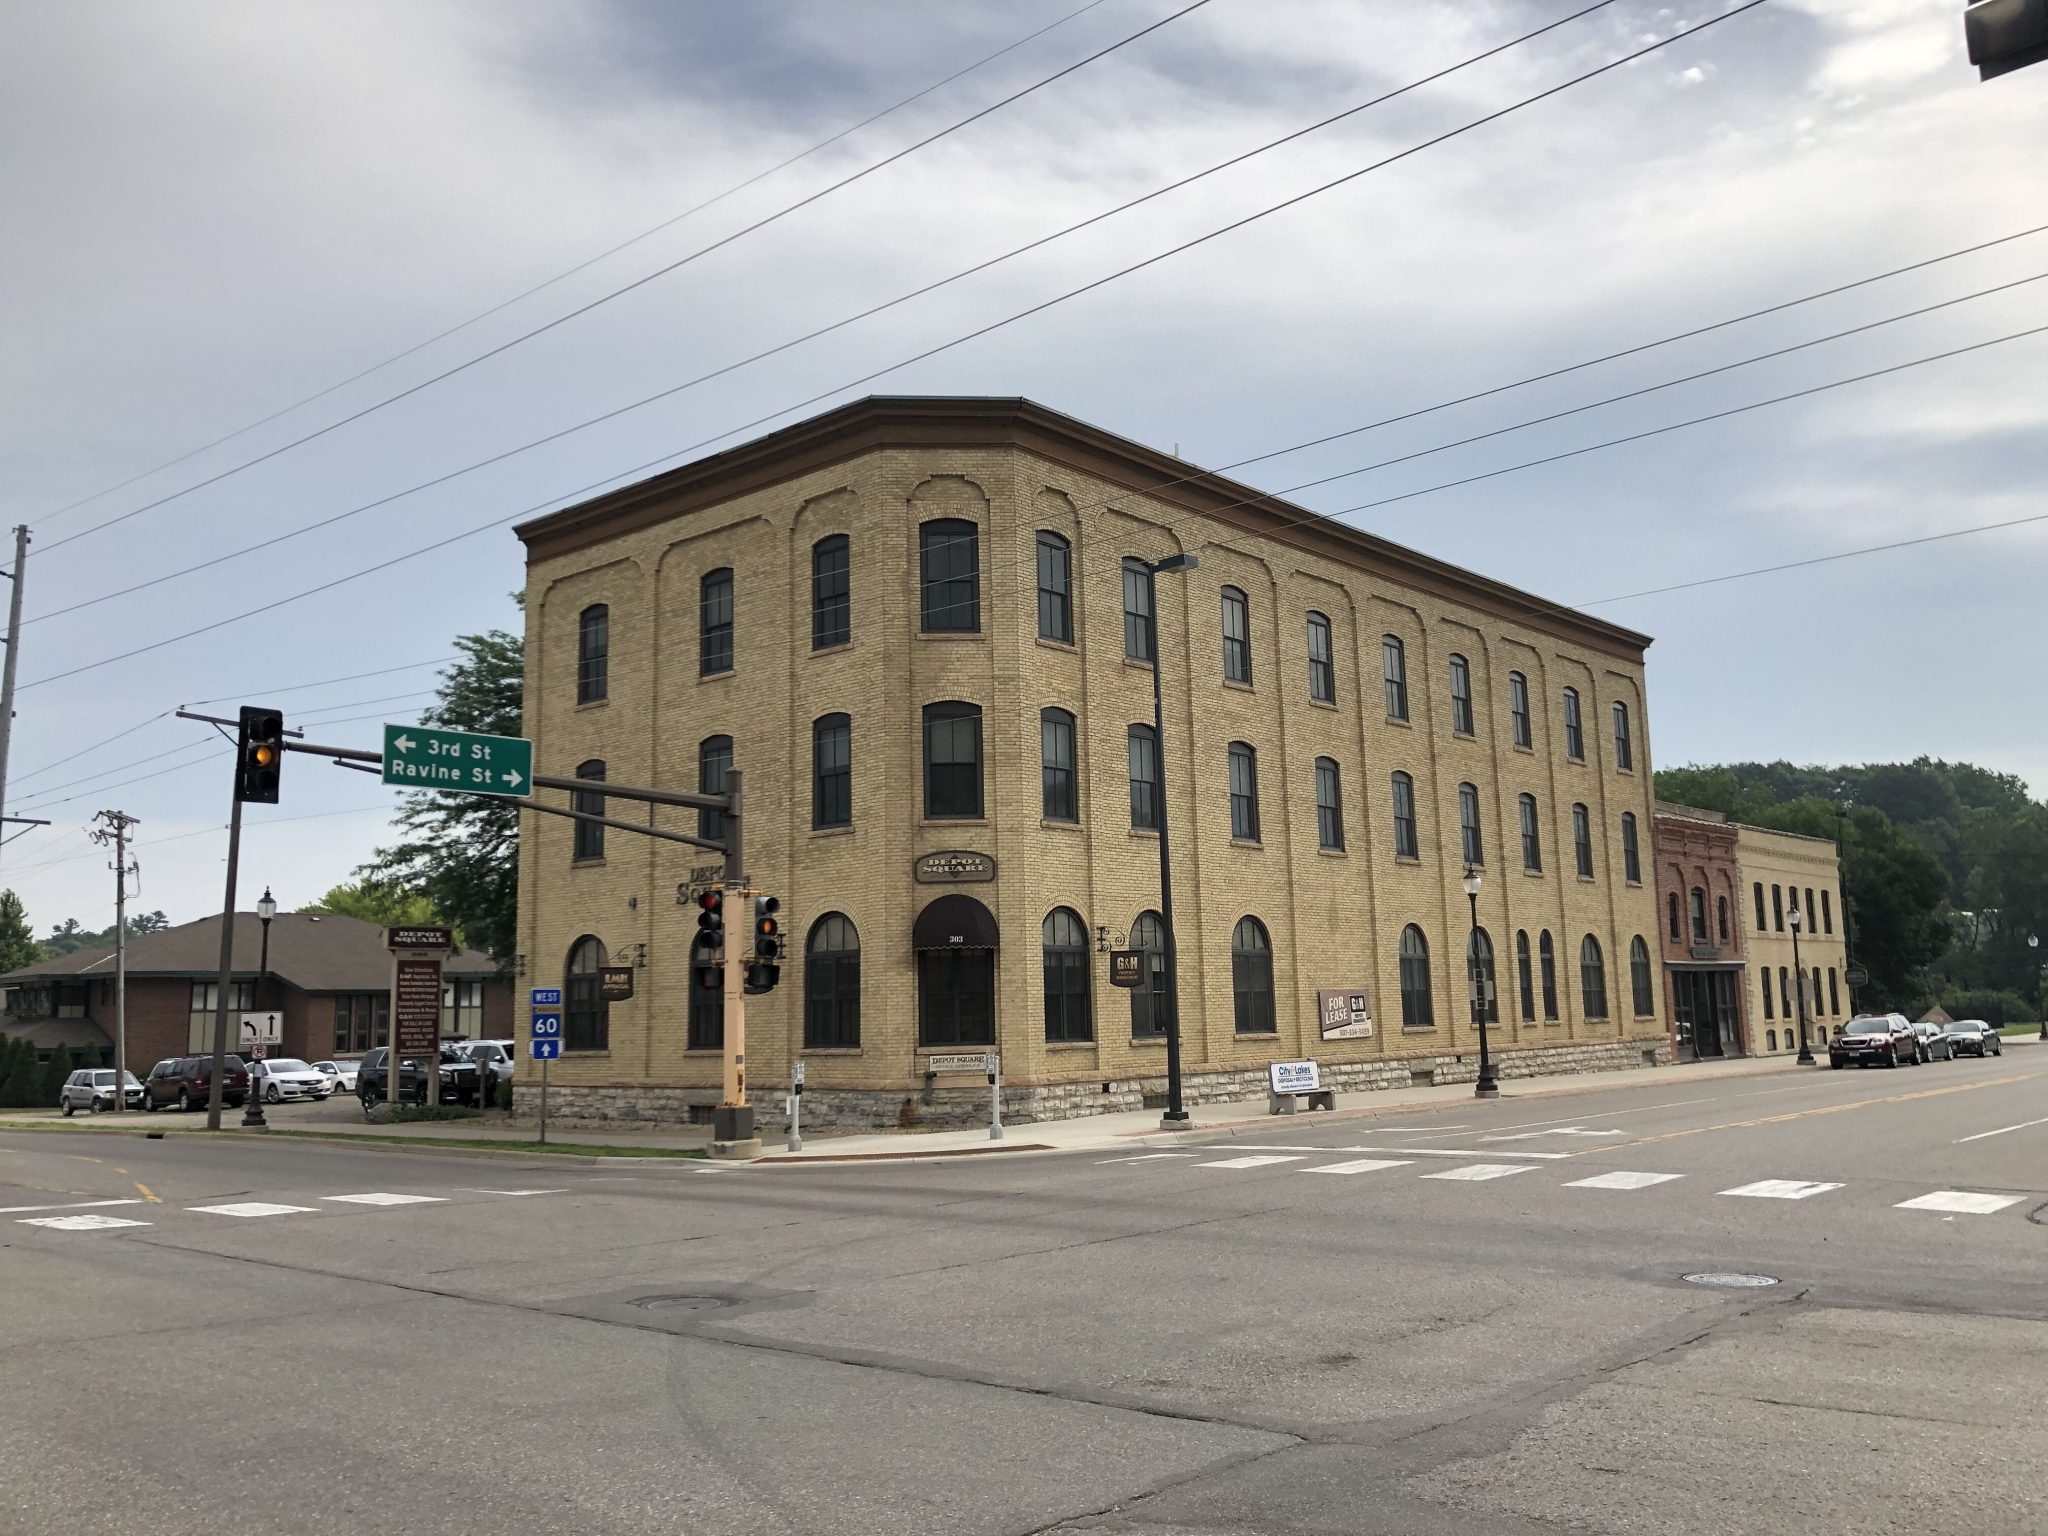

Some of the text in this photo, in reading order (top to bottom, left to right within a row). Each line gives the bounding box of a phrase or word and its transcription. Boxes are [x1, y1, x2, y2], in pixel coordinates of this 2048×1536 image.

[428, 740, 492, 760] 3rd St
[392, 760, 493, 783] Ravine St
[928, 858, 982, 866] DEPOT
[690, 866, 727, 882] DEPO
[922, 865, 988, 874] SQUARE
[949, 935, 964, 943] 303
[1117, 956, 1138, 970] G&H
[535, 992, 559, 1002] WEST
[1328, 996, 1345, 1011] FOR
[1325, 1008, 1348, 1025] LEASE
[535, 1018, 557, 1034] 60
[932, 1055, 985, 1065] DEPOT SQUARE
[1279, 1066, 1291, 1077] City
[1295, 1065, 1311, 1075] Lakes
